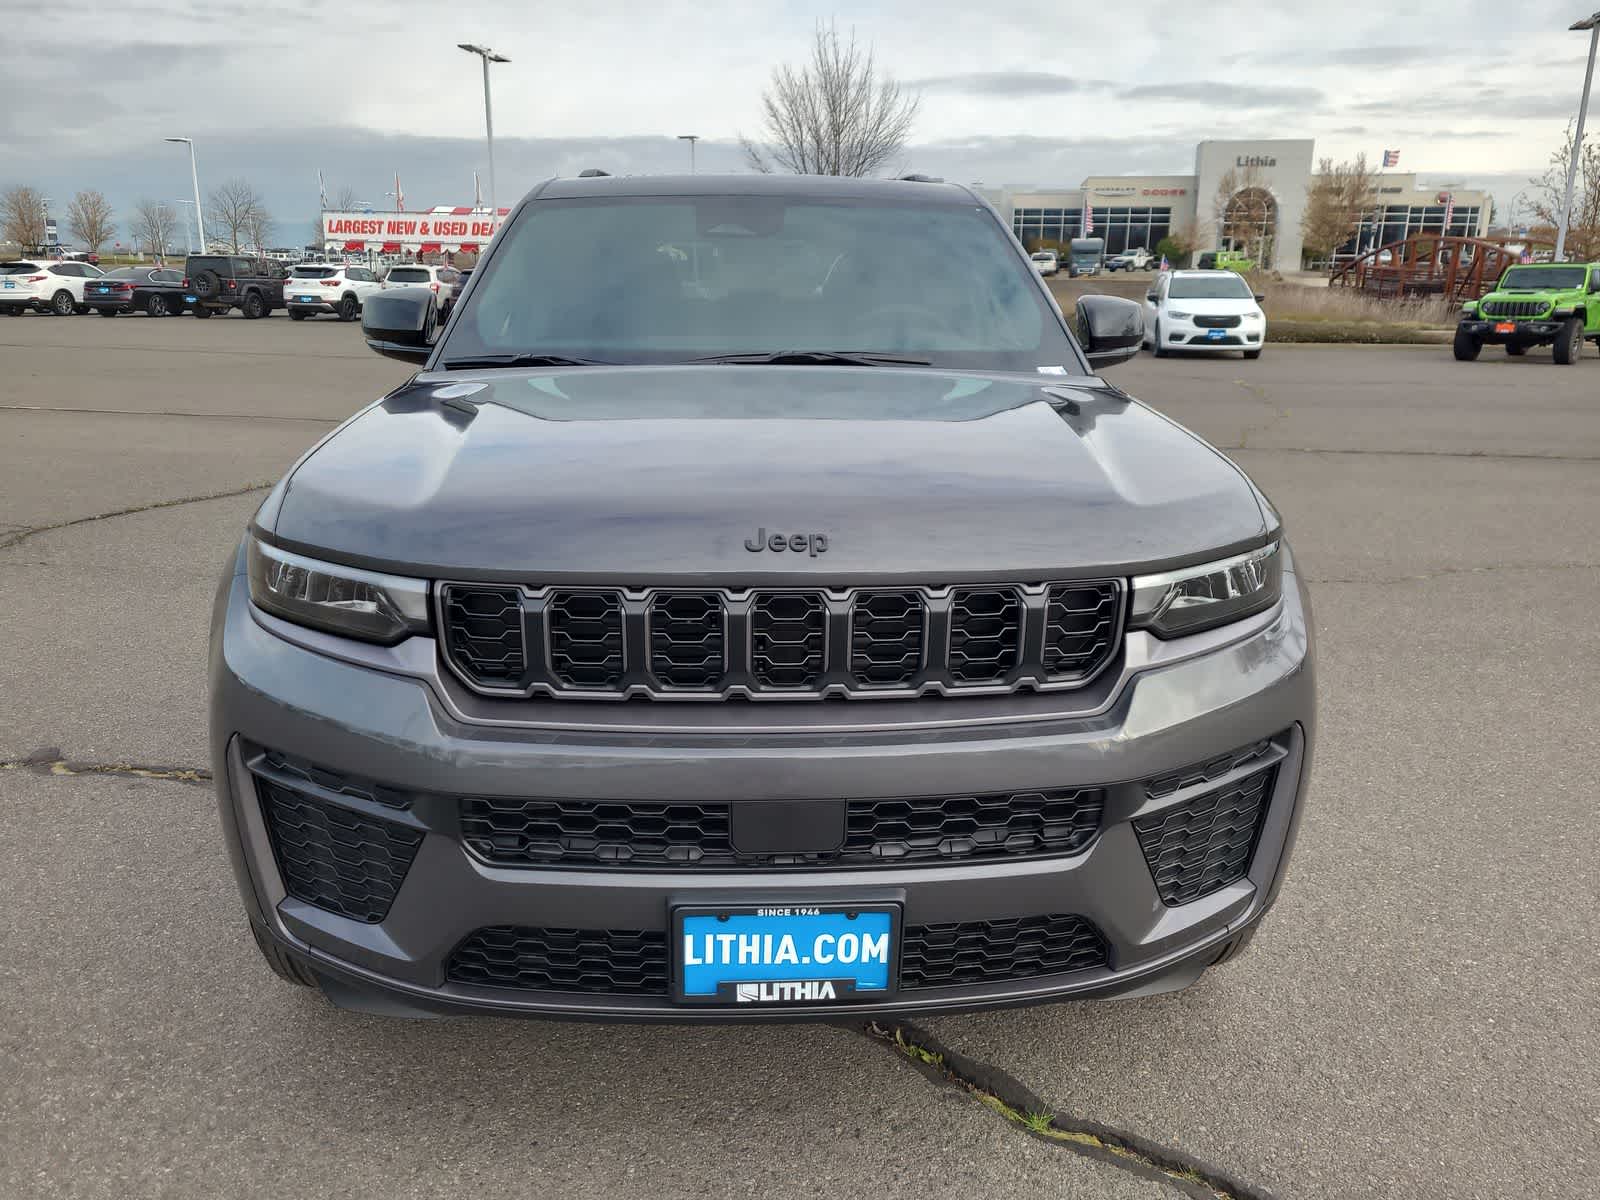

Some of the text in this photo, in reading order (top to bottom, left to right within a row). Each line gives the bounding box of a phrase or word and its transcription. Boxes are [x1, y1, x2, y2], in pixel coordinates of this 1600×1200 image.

[1236, 155, 1277, 168] Lithia
[328, 219, 502, 236] LARGEST NEW & USED DEA
[743, 527, 829, 557] Jeep
[757, 908, 820, 917] SINCE 1946
[684, 933, 889, 965] LITHIA.COM
[759, 981, 836, 1001] LITHIA
